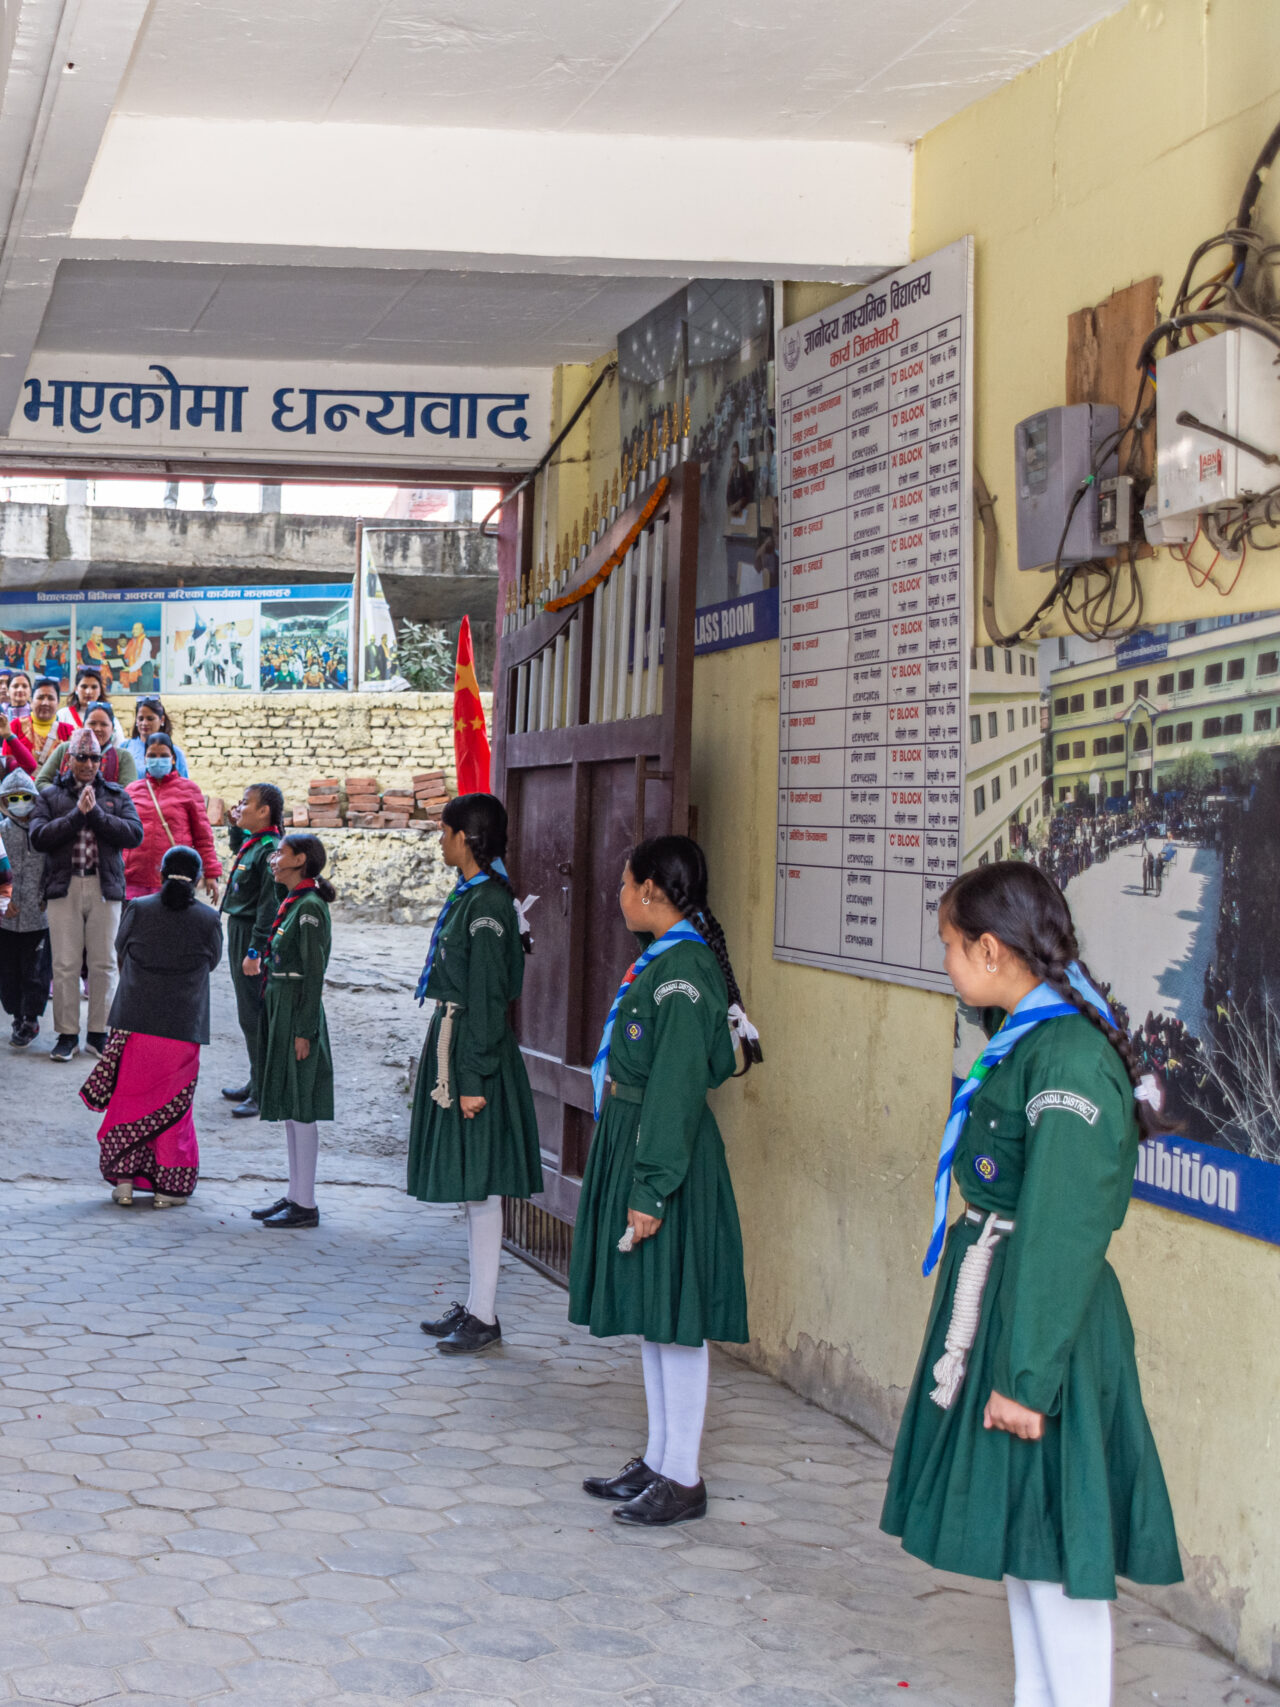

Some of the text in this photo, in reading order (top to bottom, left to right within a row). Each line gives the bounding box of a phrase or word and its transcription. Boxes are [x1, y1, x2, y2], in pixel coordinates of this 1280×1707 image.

[803, 271, 932, 355] ज्ञानोदय माध्यमिक विद्यालय
[830, 318, 899, 368] कार्य जिम्मेवारी
[23, 364, 249, 433] भएकोमा
[272, 387, 533, 442] धन्यवाद
[721, 602, 754, 640] ROOM
[1062, 1095, 1094, 1116] DISTRICT
